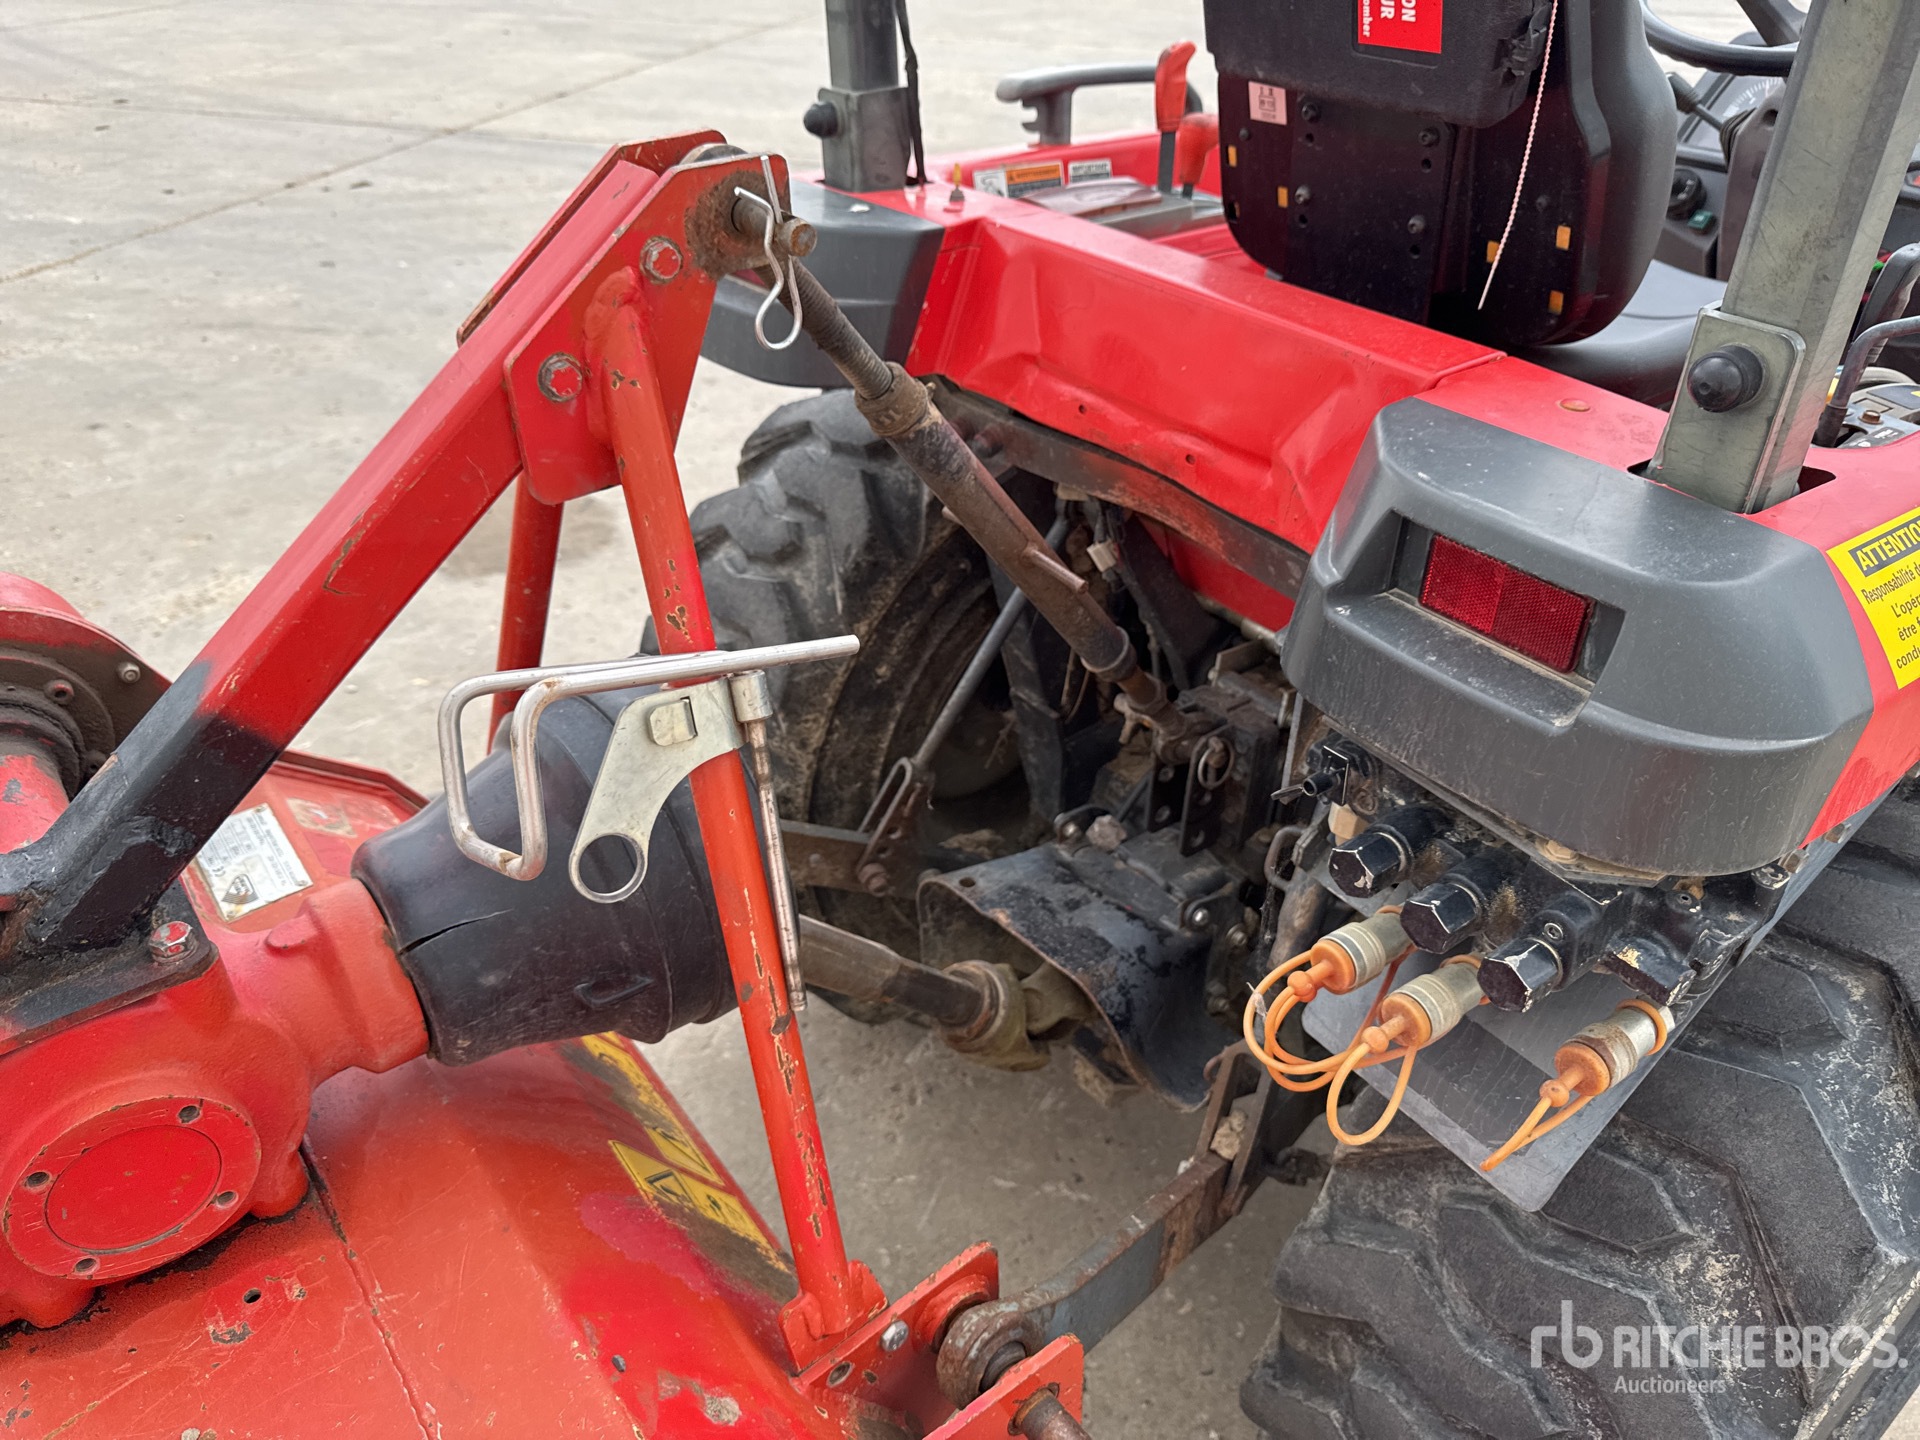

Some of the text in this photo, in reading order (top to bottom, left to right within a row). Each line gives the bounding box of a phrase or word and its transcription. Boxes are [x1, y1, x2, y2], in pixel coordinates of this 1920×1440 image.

[1856, 520, 1920, 571] ATTENTIO
[1861, 564, 1916, 604] Responsabilité
[1891, 593, 1920, 619] L'opér
[1897, 623, 1918, 641] être
